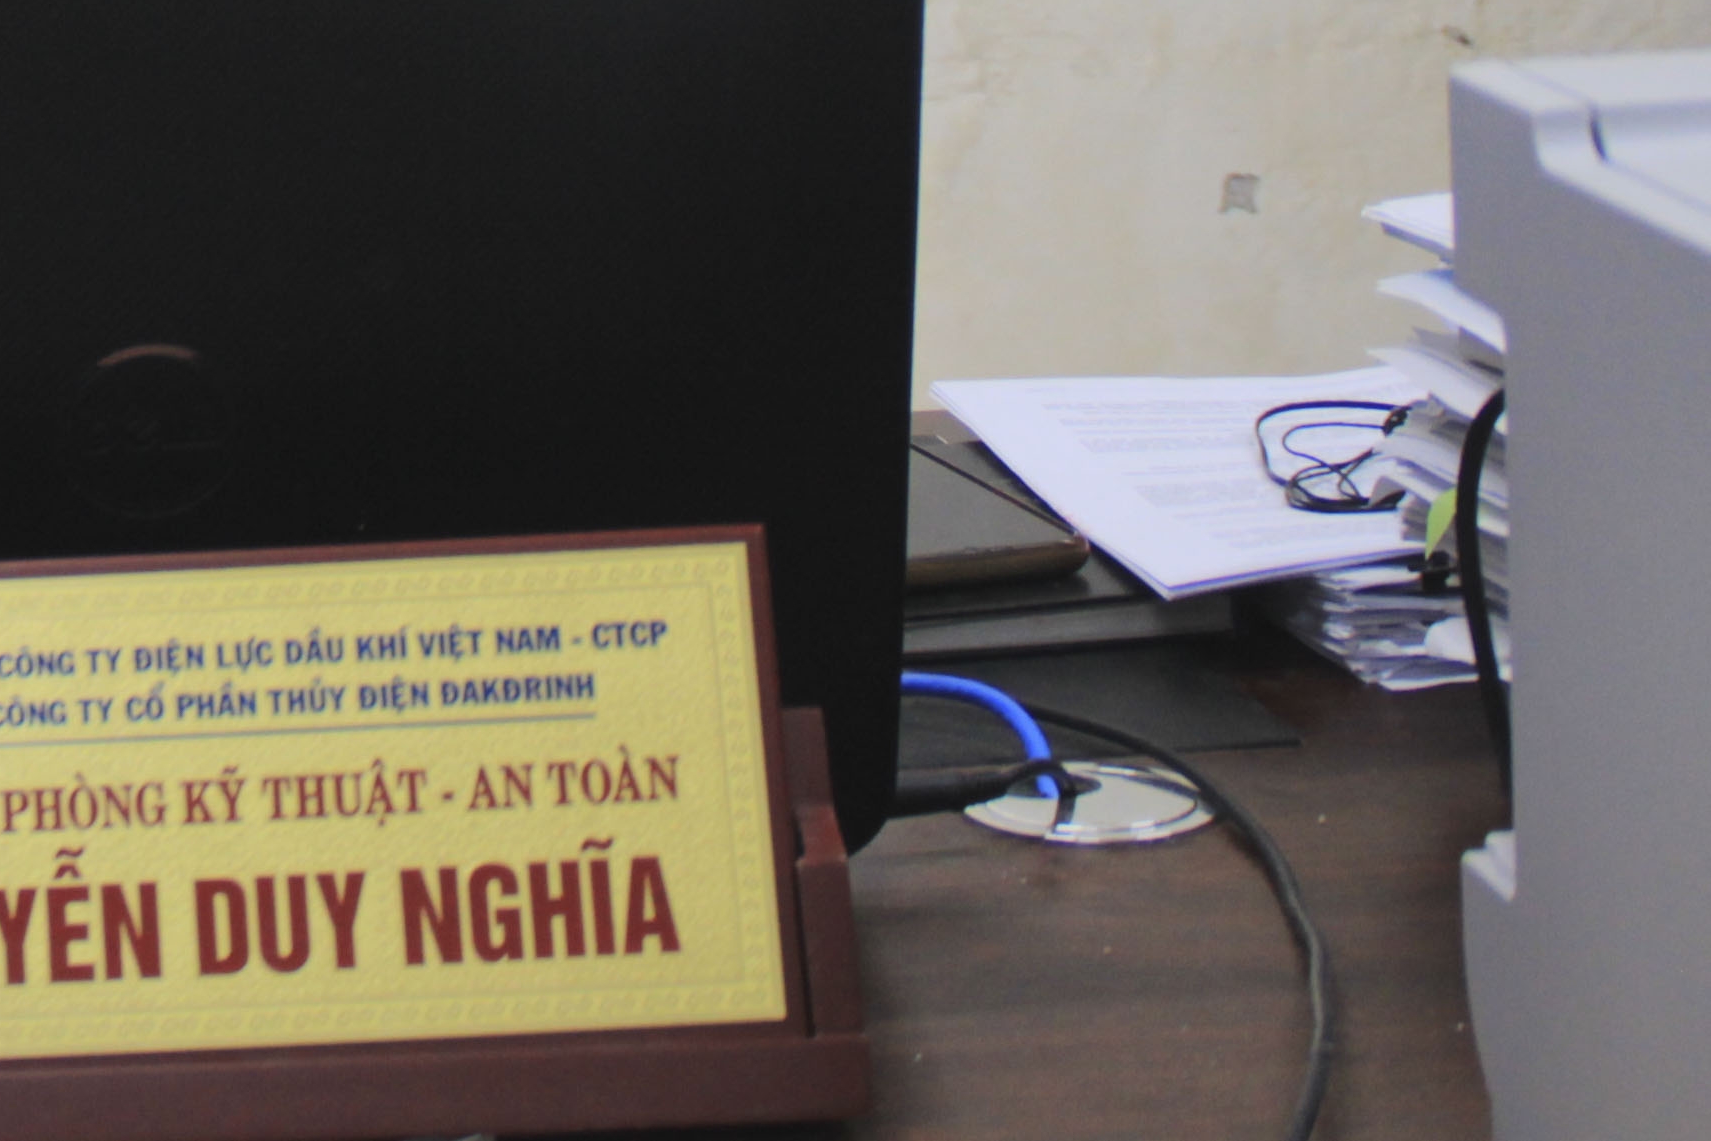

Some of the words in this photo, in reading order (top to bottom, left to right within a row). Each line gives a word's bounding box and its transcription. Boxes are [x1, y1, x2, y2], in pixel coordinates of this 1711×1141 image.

[85, 648, 121, 675] TY
[133, 638, 204, 675] ĐIỆN
[217, 636, 273, 674] LỰC
[355, 623, 409, 661] KHÍ
[418, 622, 483, 662] VIỆT
[495, 626, 561, 656] NAM
[592, 620, 668, 650] CTCP
[78, 697, 114, 724] TY
[357, 673, 430, 714] ĐIỆN
[441, 672, 595, 707] ĐAKĐRINH
[0, 772, 167, 835] PHÒNG
[181, 765, 247, 825] KỸ
[261, 758, 428, 827] THUẬT
[467, 762, 533, 812] AN
[547, 743, 680, 806] TOÀN
[194, 871, 366, 976] DUY
[400, 836, 682, 966] NGHĨA
